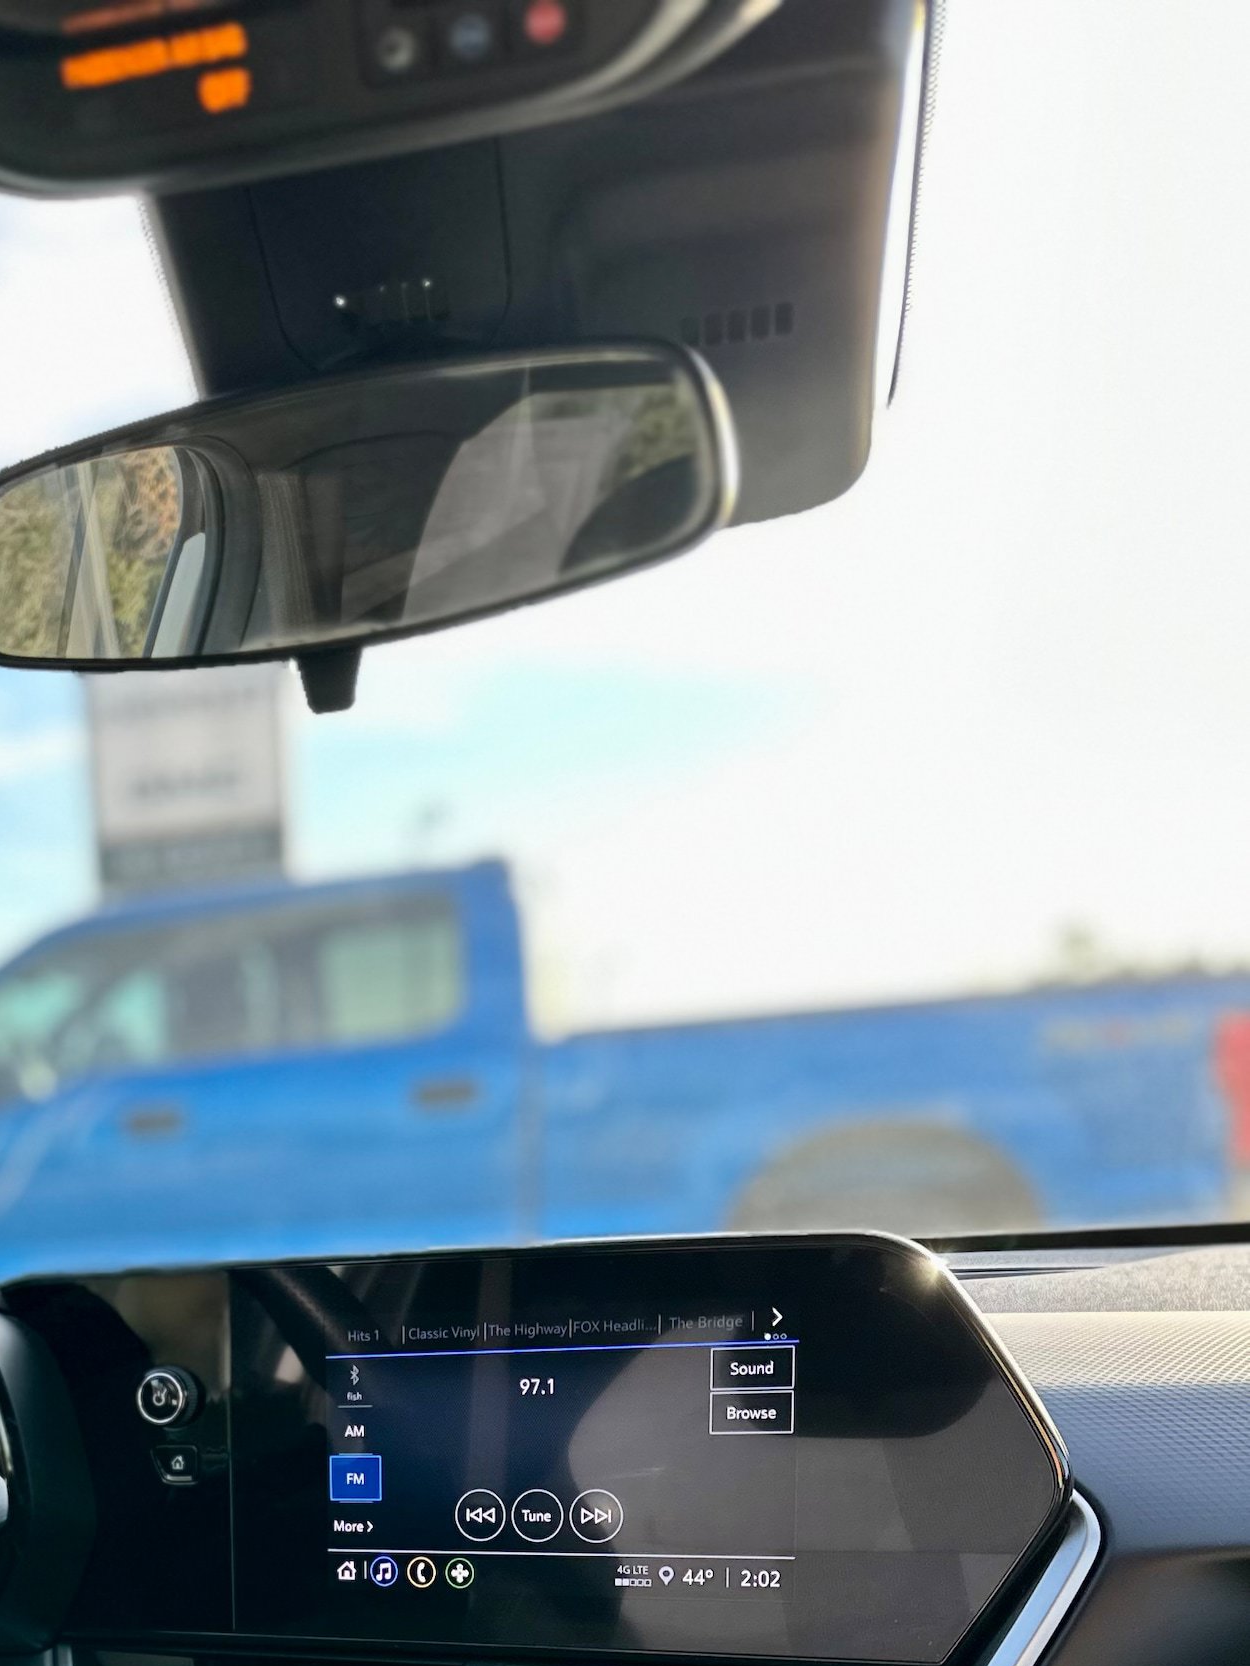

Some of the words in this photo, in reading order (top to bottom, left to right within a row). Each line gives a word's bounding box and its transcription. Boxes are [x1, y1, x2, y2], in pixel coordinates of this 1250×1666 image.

[488, 1324, 511, 1337] The
[515, 1322, 568, 1338] Highway
[573, 1320, 600, 1333] FOX
[669, 1316, 695, 1330] The
[698, 1315, 743, 1331] Bridge
[348, 1330, 371, 1342] Hits
[374, 1329, 380, 1341] 1
[408, 1327, 448, 1340] Classic
[451, 1325, 480, 1342] Vinyl
[730, 1360, 774, 1376] Sound
[520, 1378, 555, 1395] 97.1
[347, 1391, 362, 1401] fish
[726, 1406, 777, 1420] Browse
[344, 1425, 365, 1438] AM
[346, 1473, 365, 1485] FM
[521, 1509, 552, 1523] Tune
[334, 1520, 364, 1533] More
[617, 1565, 631, 1574] 4G
[632, 1565, 649, 1575] LTE
[740, 1569, 781, 1588] 2:02
